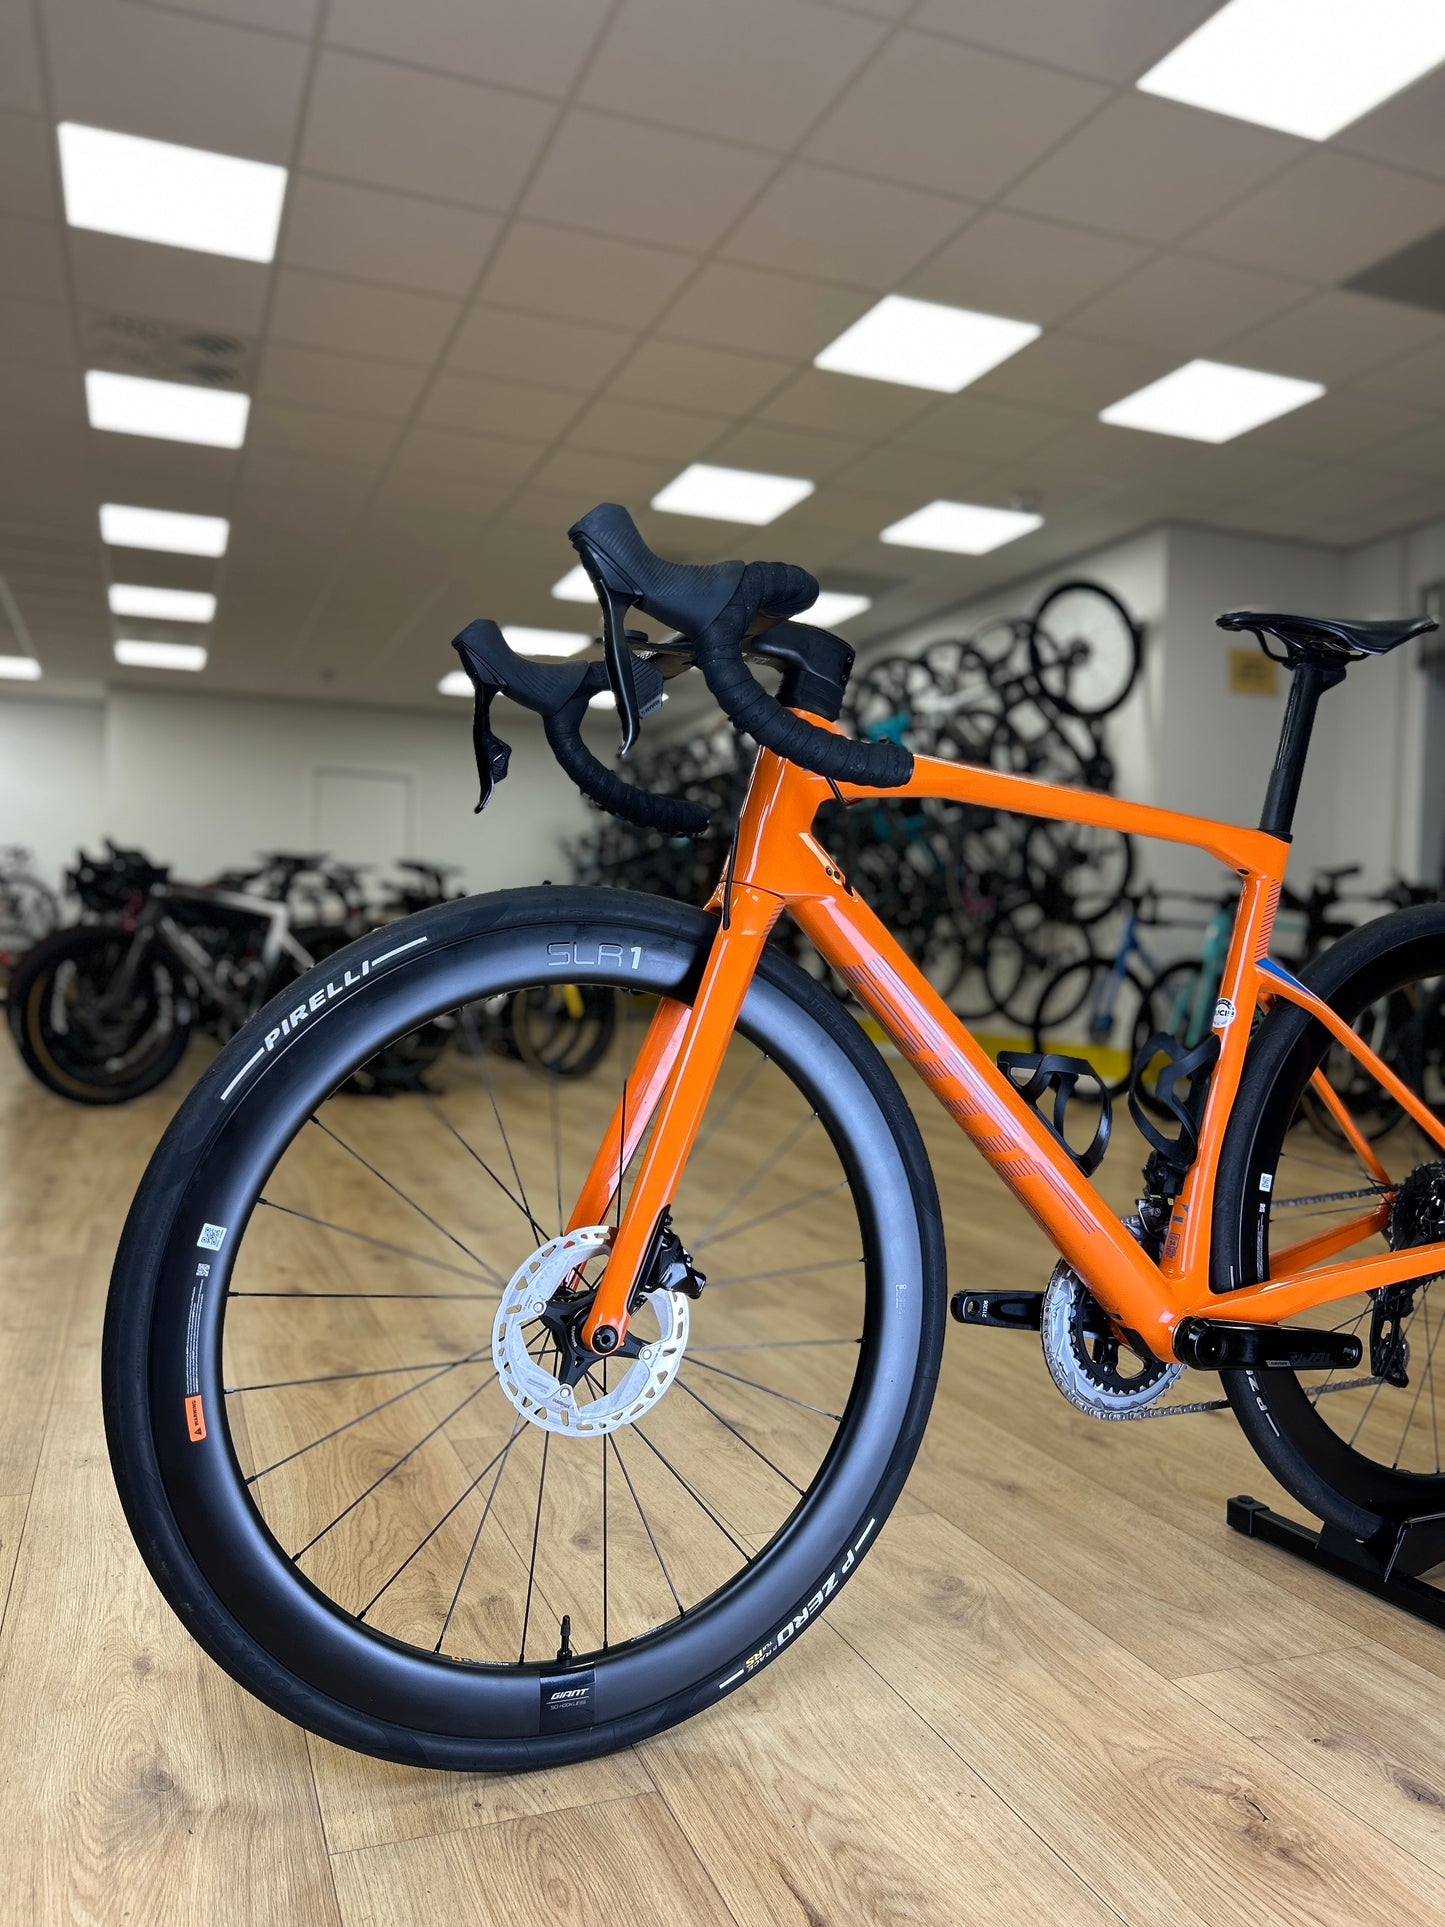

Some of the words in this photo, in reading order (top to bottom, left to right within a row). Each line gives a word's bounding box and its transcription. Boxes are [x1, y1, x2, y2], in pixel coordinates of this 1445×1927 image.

[264, 959, 370, 1052] PIRELLI
[192, 1399, 200, 1427] WARNING
[841, 1548, 855, 1574] P
[777, 1572, 839, 1646] ZERO
[745, 1649, 764, 1666] RS
[550, 1688, 590, 1700] GIANT
